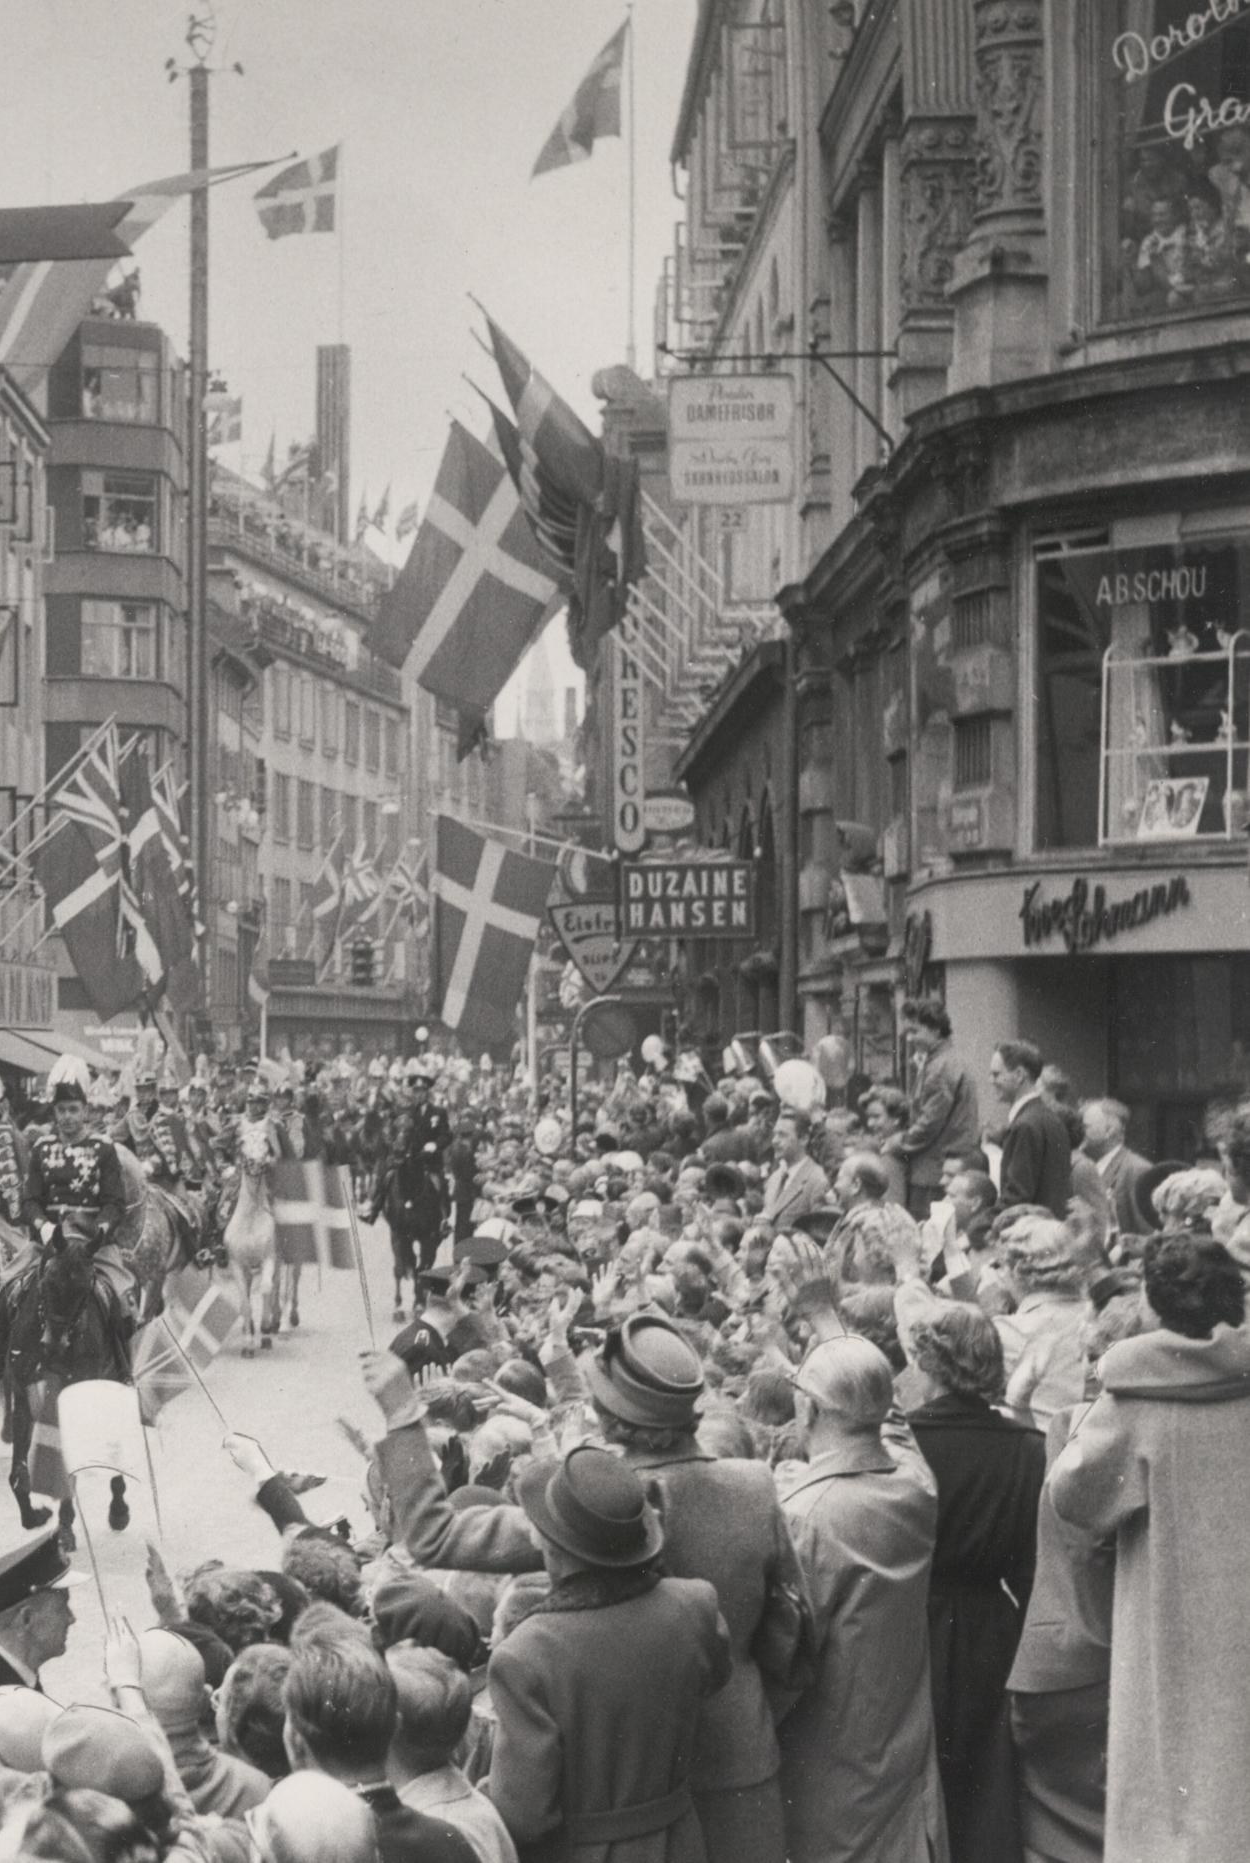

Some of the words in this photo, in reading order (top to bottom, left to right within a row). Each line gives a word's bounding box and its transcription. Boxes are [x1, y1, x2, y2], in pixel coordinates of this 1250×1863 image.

[1095, 566, 1208, 606] ABSCHOU
[628, 870, 749, 898] DUZAINE
[628, 901, 749, 928] HANSEN
